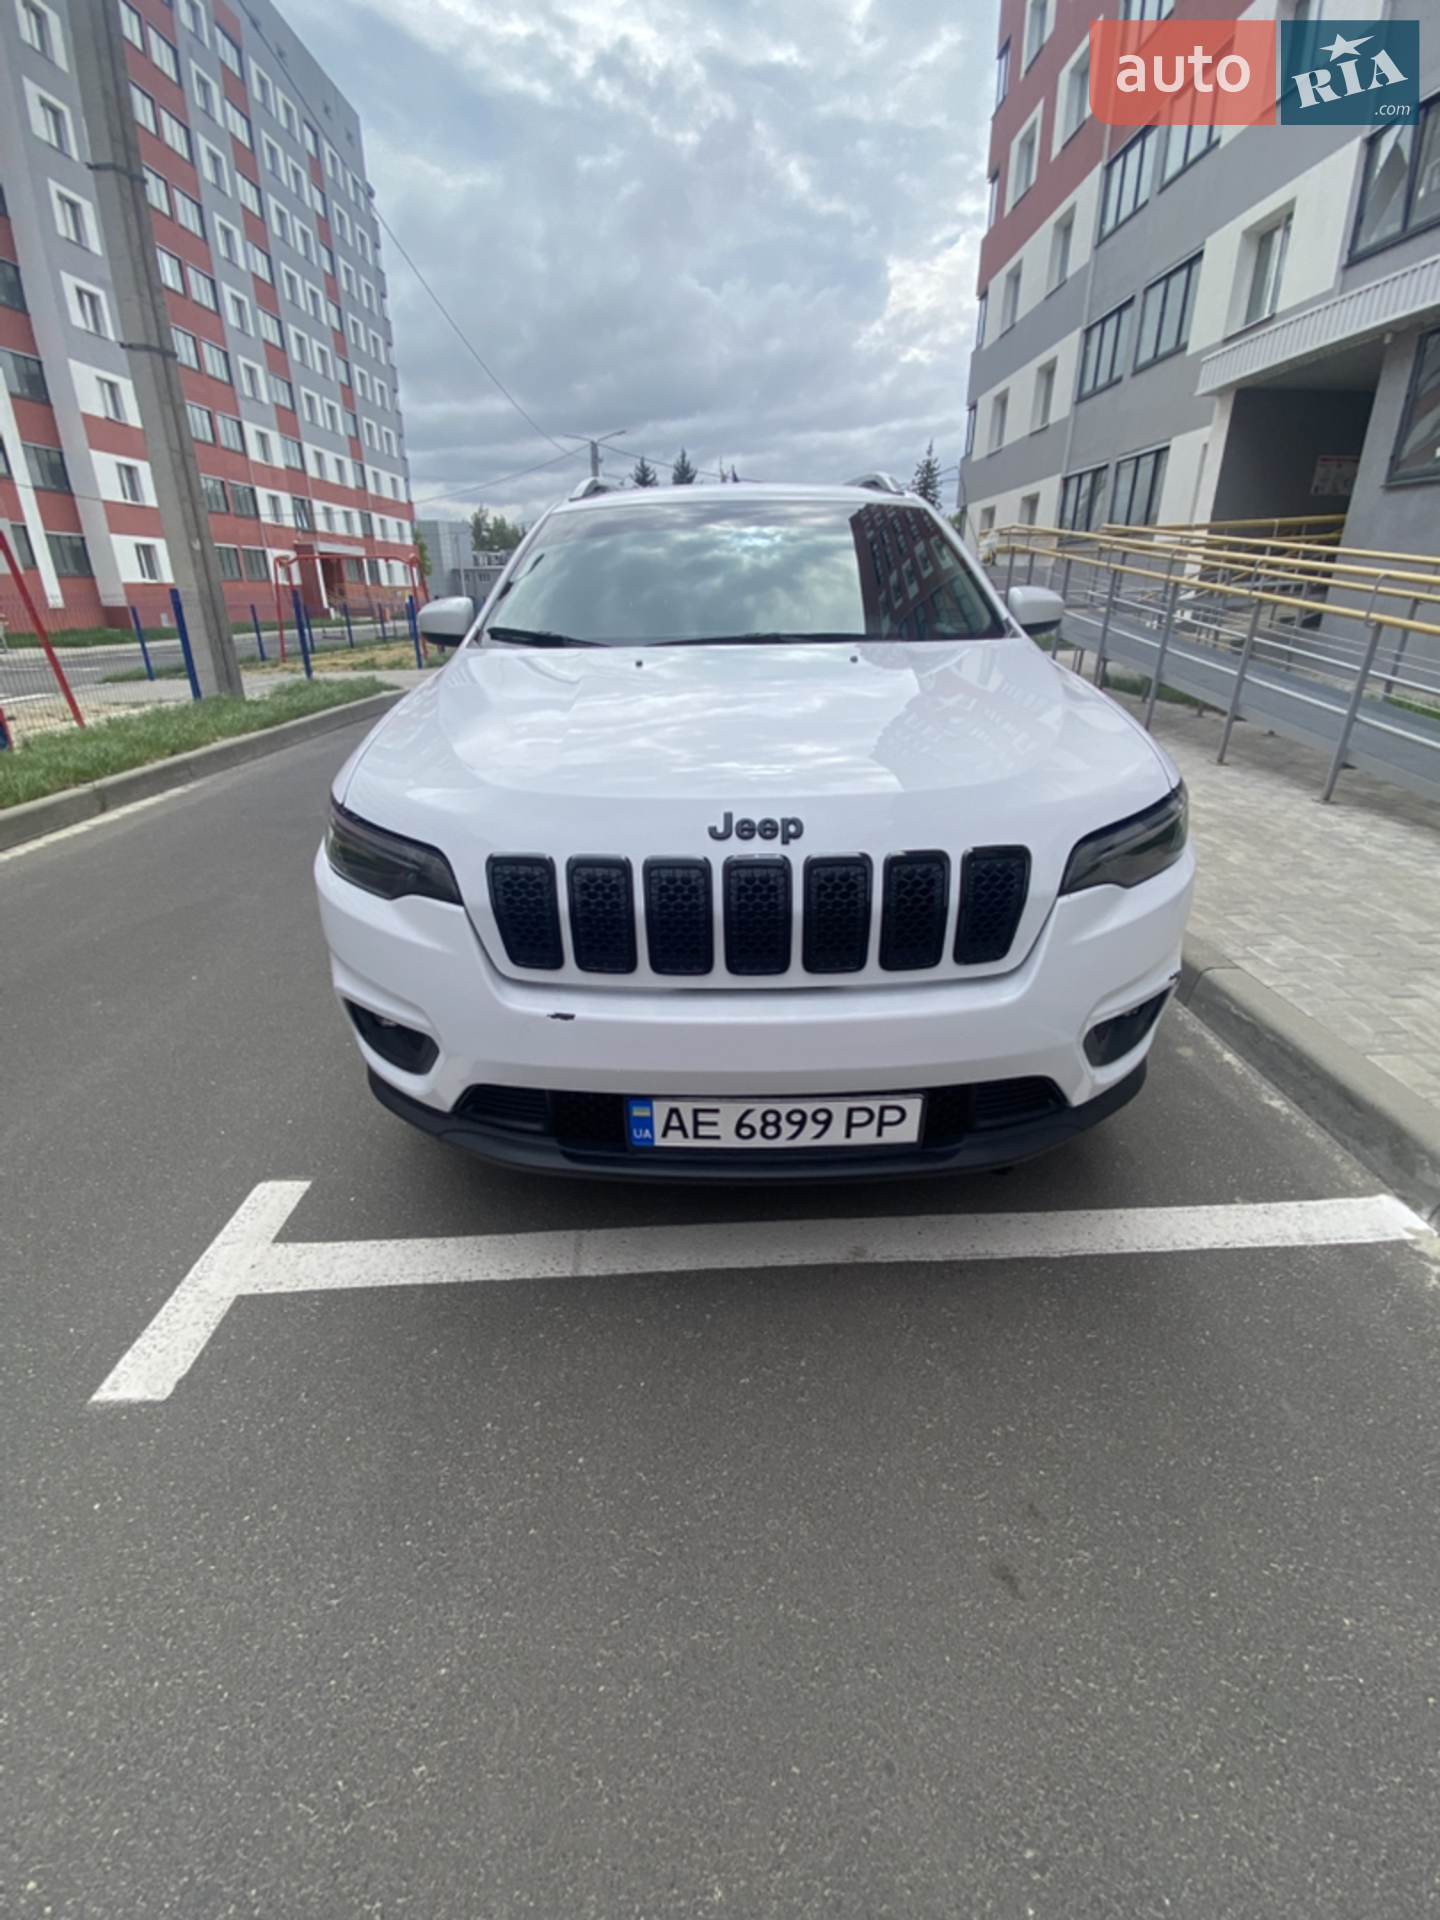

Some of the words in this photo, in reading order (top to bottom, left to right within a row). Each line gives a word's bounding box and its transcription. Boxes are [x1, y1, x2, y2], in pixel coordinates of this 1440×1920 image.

[707, 811, 804, 845] Jeep
[633, 1128, 652, 1140] UA
[661, 1106, 721, 1140] AE
[734, 1107, 834, 1141] 6899
[844, 1104, 907, 1139] PP
